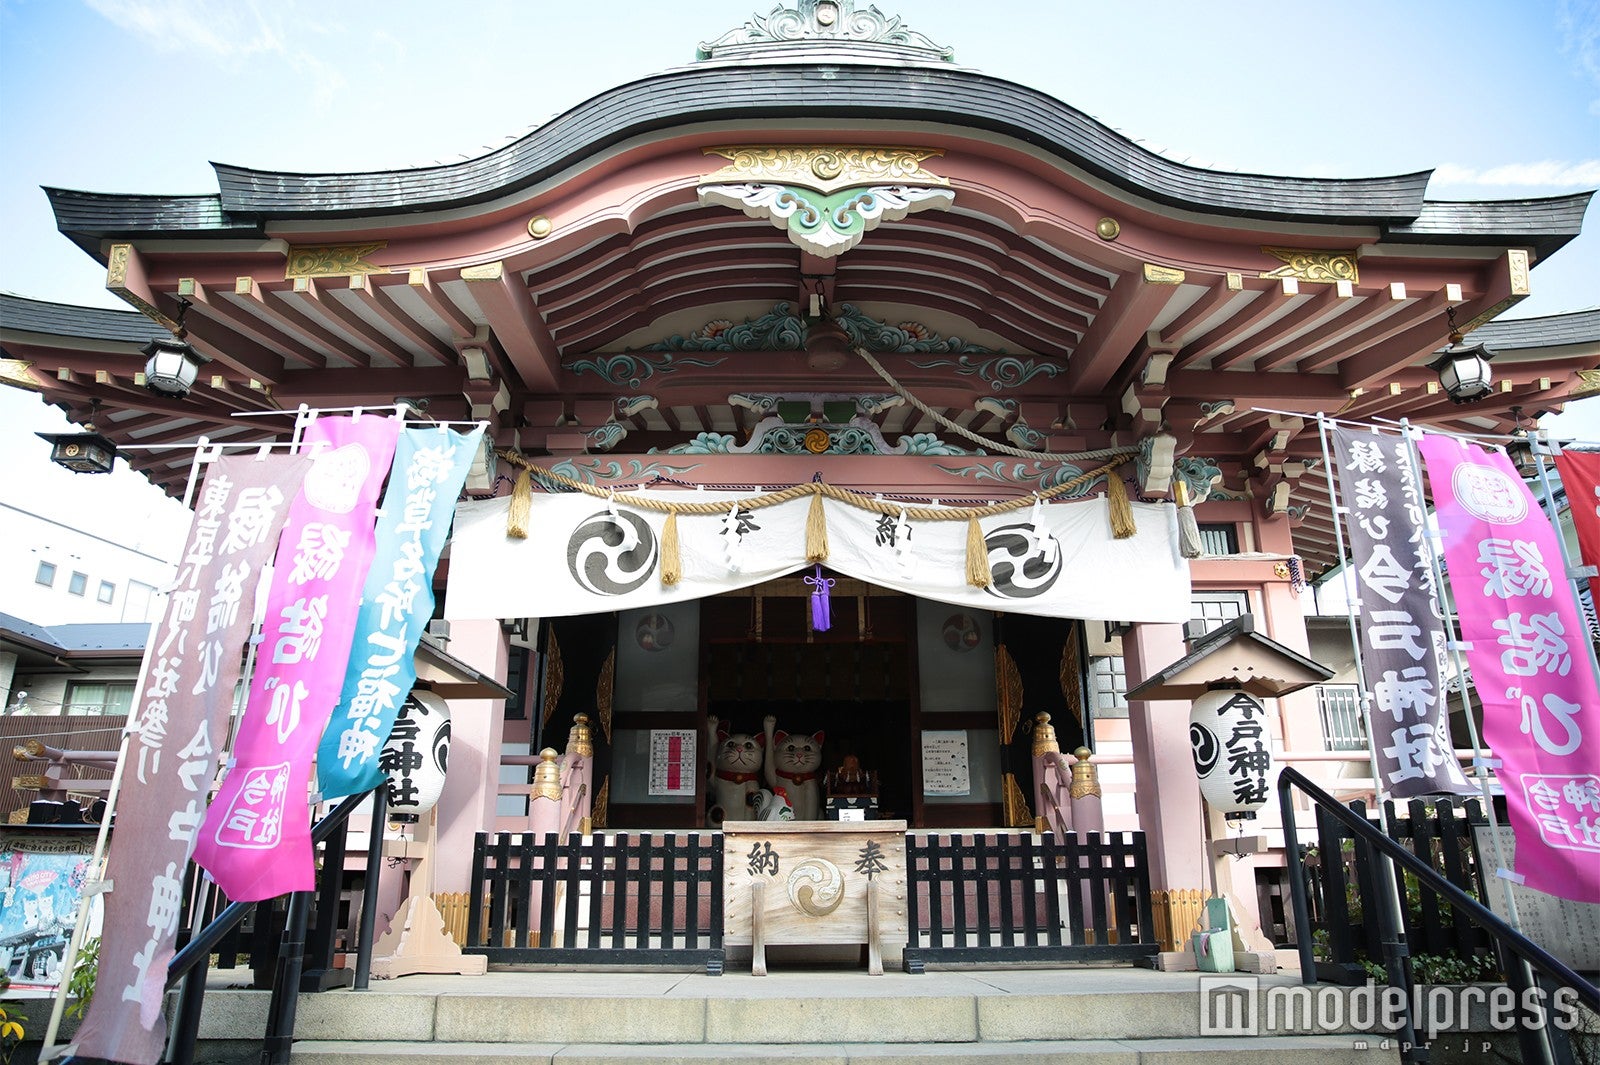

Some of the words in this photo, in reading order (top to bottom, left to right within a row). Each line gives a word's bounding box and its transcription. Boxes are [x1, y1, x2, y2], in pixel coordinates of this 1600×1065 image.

[1217, 692, 1270, 804] 今戸神社
[746, 841, 779, 877] 納
[855, 839, 889, 881] 奉
